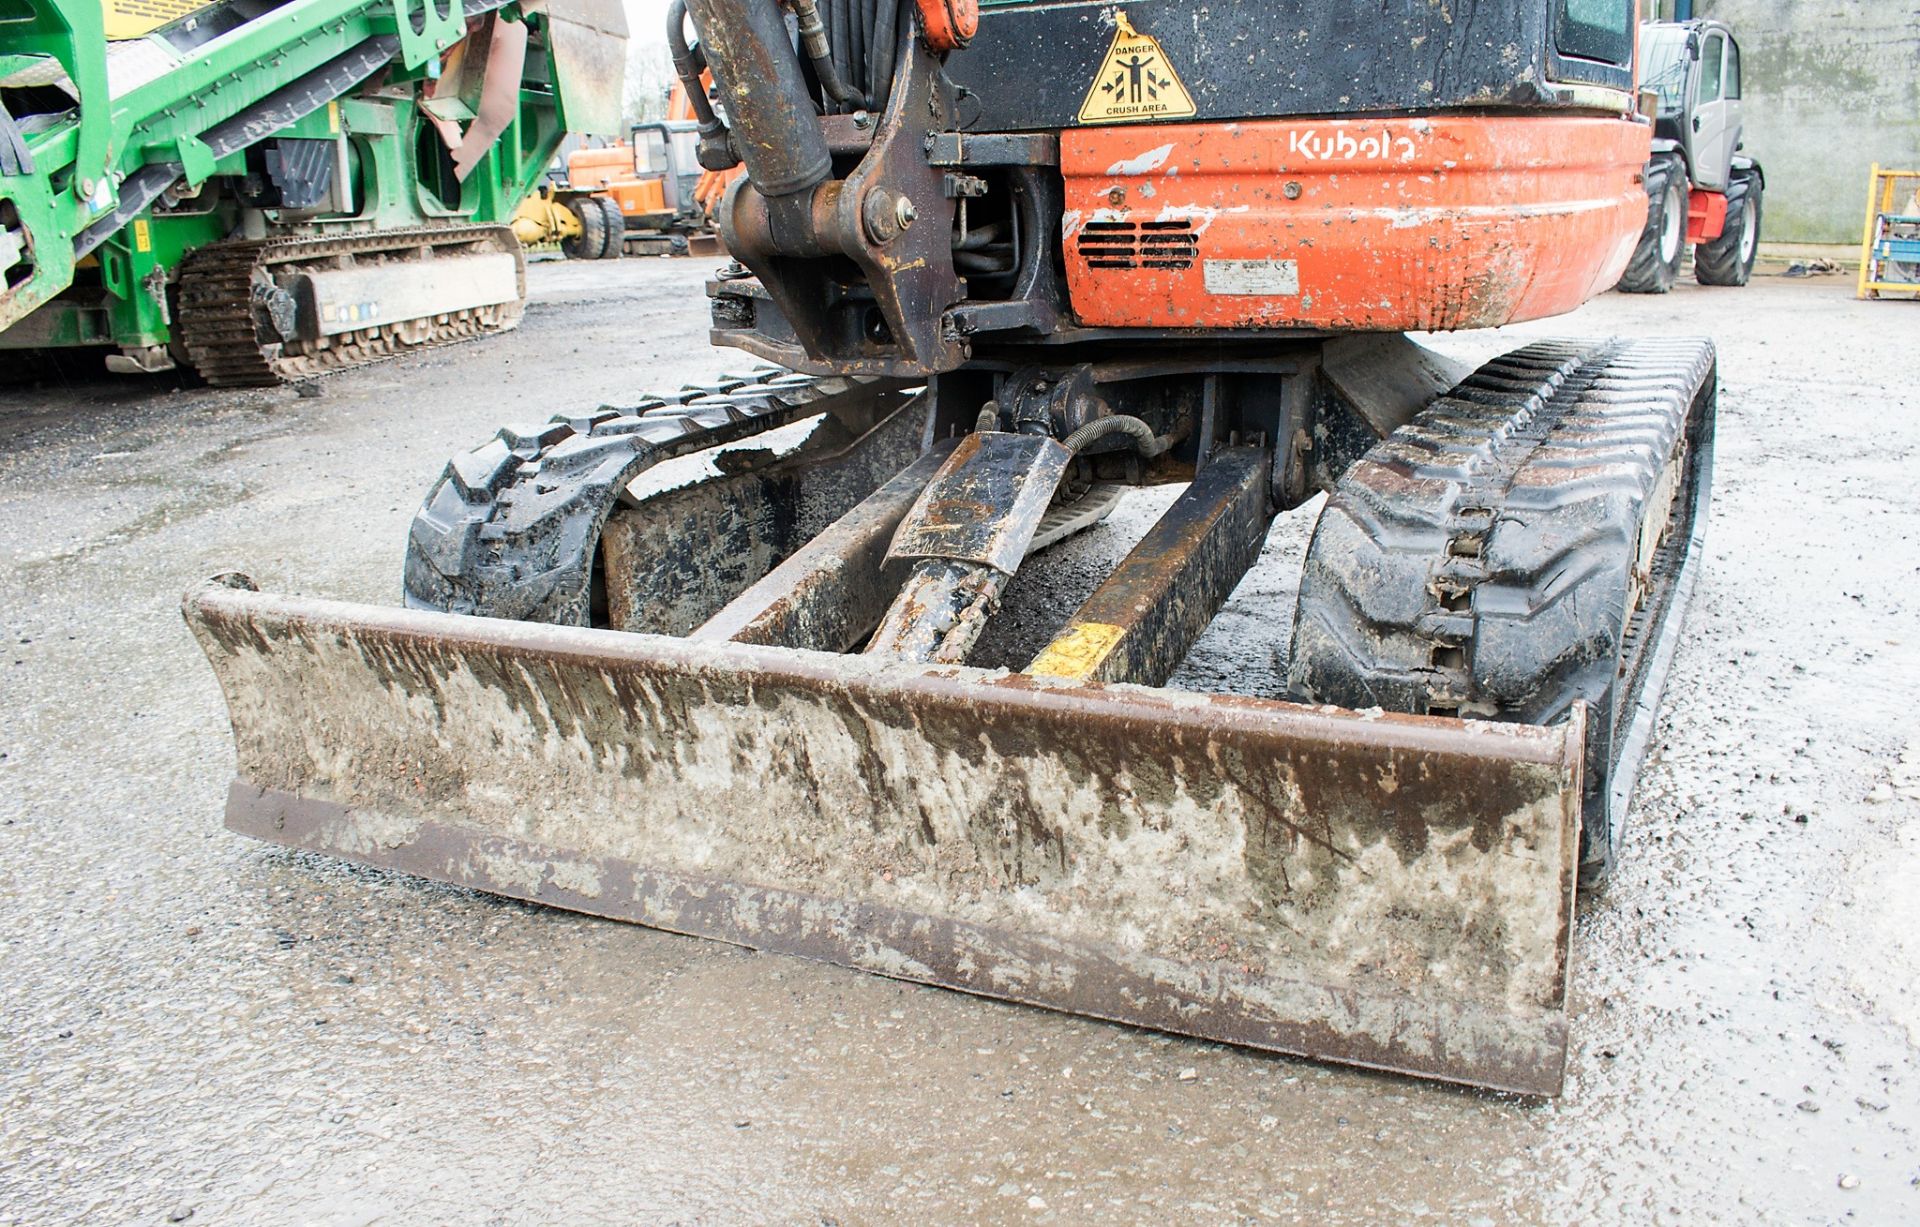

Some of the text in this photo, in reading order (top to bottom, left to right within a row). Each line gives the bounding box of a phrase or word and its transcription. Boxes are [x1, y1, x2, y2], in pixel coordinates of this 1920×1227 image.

[1115, 45, 1155, 55] DANGER
[1106, 104, 1168, 115] CRUSH AREA
[1289, 129, 1416, 161] Kubota
